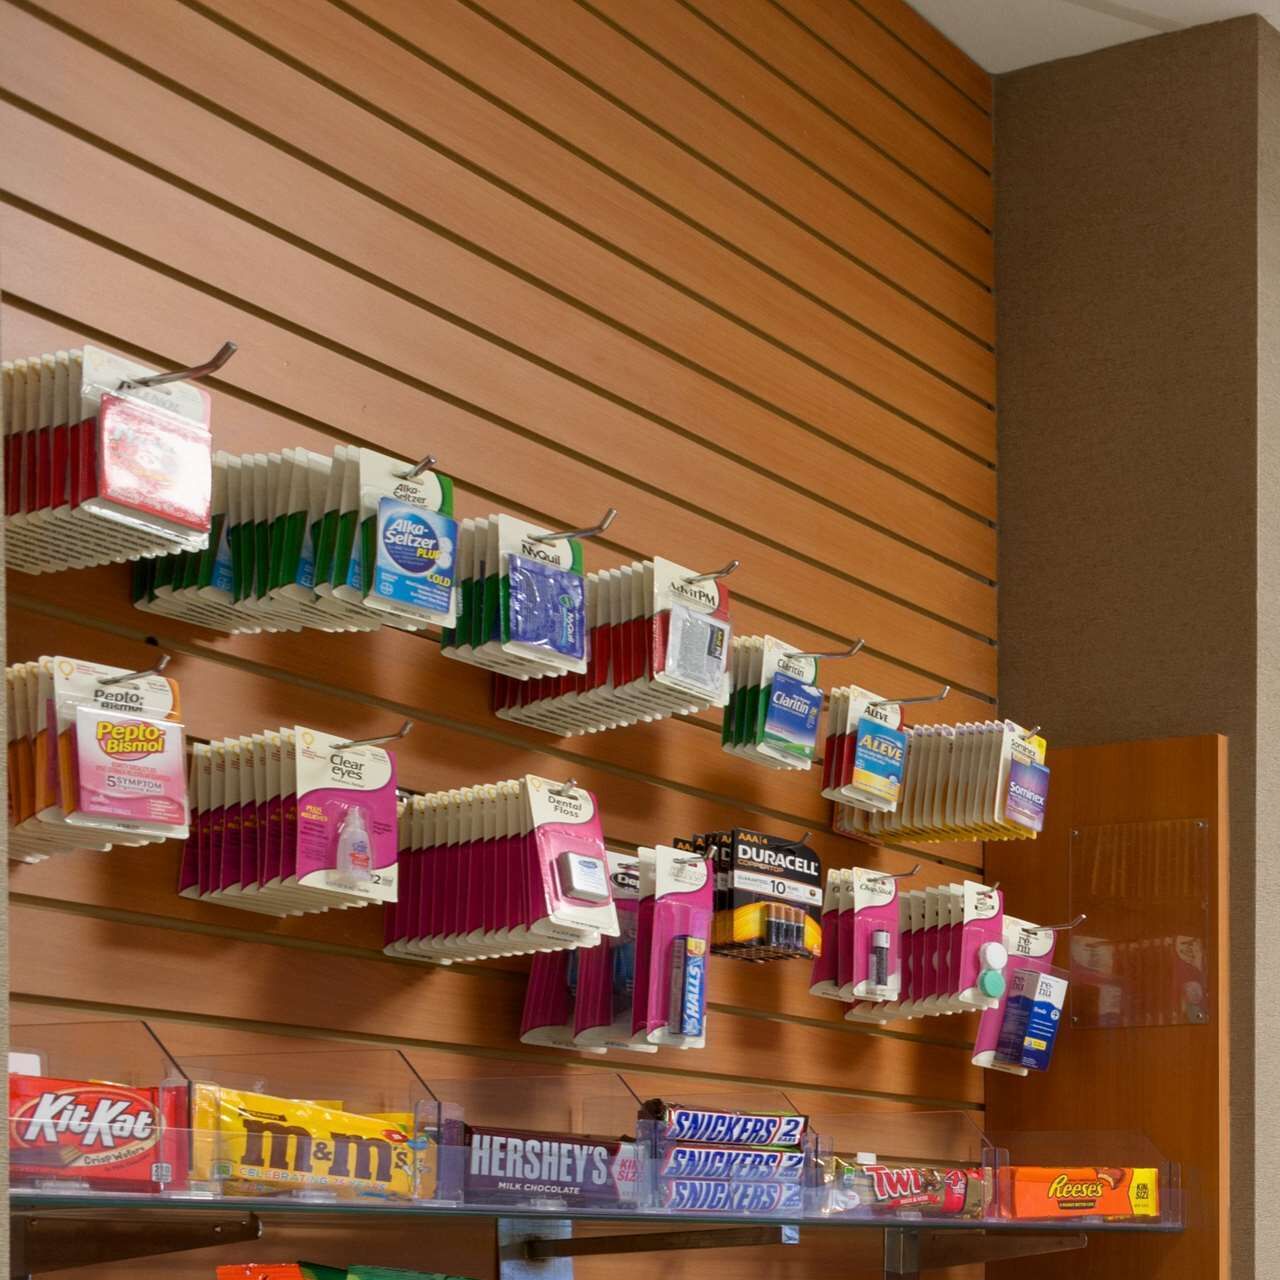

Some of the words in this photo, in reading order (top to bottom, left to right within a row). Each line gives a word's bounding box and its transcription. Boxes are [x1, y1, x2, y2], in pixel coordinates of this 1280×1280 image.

[389, 519, 429, 534] Alka-
[384, 530, 437, 549] Seltzer
[426, 572, 451, 587] COLD
[773, 691, 809, 715] Claritin
[864, 705, 889, 723] ALEVE
[96, 721, 166, 741] Pepto-
[105, 738, 165, 753] Bismol
[860, 735, 903, 761] ALEVE
[330, 754, 364, 771] Clear
[331, 765, 362, 780] eyes
[1009, 781, 1045, 806] Sominex
[547, 795, 583, 812] Dental
[553, 805, 579, 819] Floss
[738, 844, 819, 876] DURACELL
[770, 880, 786, 895] 10
[674, 1112, 778, 1144] SNICKERS
[784, 1119, 800, 1137] 2
[471, 1134, 609, 1186] HERSHEY'S
[668, 1150, 778, 1178] SNICKERS
[498, 1181, 522, 1193] MILK
[523, 1184, 581, 1197] CHOCOLATE
[673, 1181, 778, 1210] SNICKERS
[1048, 1175, 1102, 1199] Reese's
